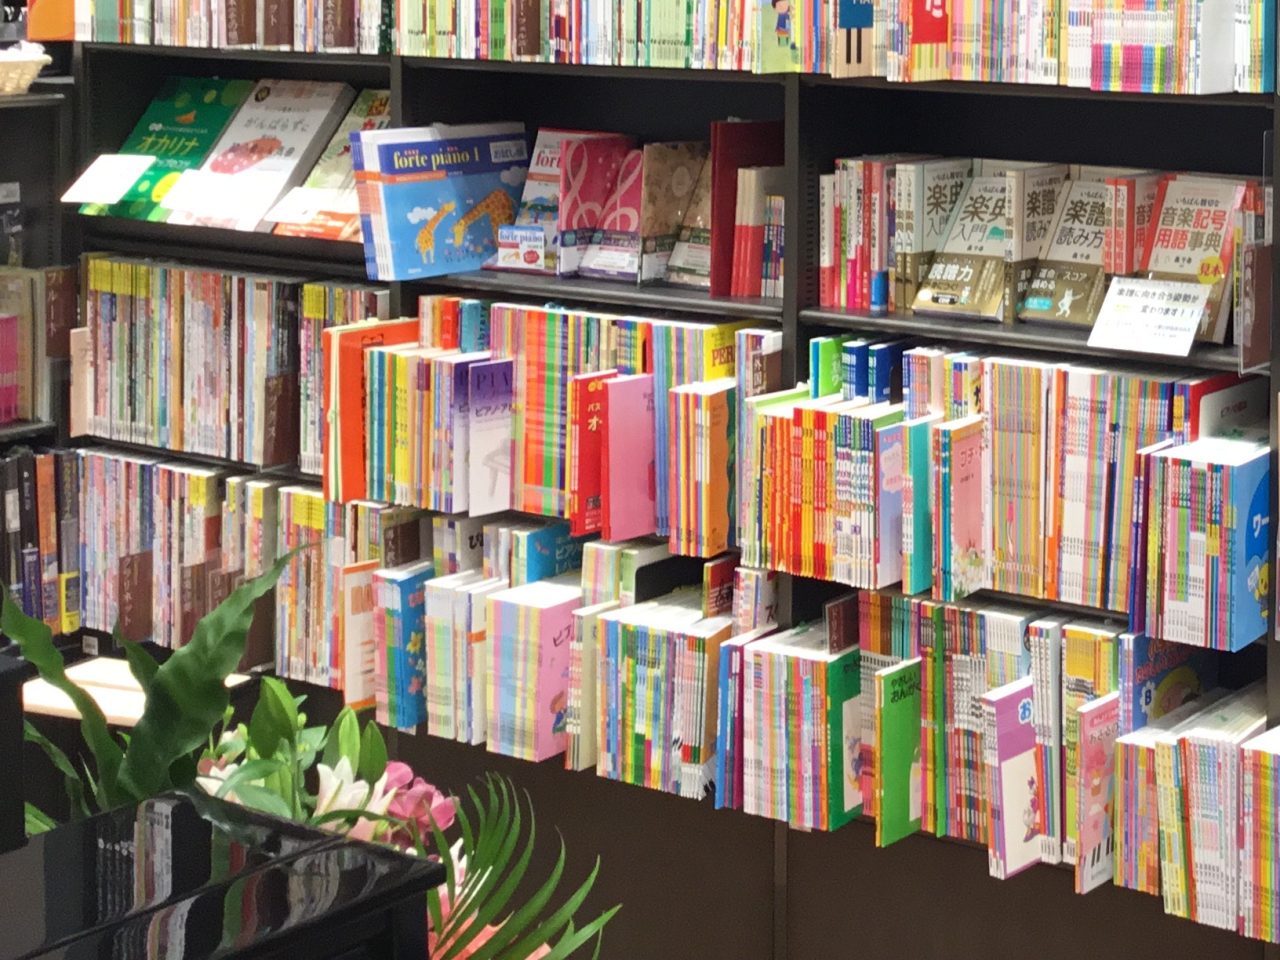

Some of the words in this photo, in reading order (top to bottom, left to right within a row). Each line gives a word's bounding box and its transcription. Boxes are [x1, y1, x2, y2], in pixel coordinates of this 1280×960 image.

[393, 149, 428, 169] forte
[431, 148, 471, 171] piano
[1160, 205, 1227, 232] 音楽記号
[952, 222, 987, 244] 入門
[1055, 225, 1104, 250] 読み方
[1153, 227, 1223, 253] 用語事典
[1199, 262, 1222, 278] 見本
